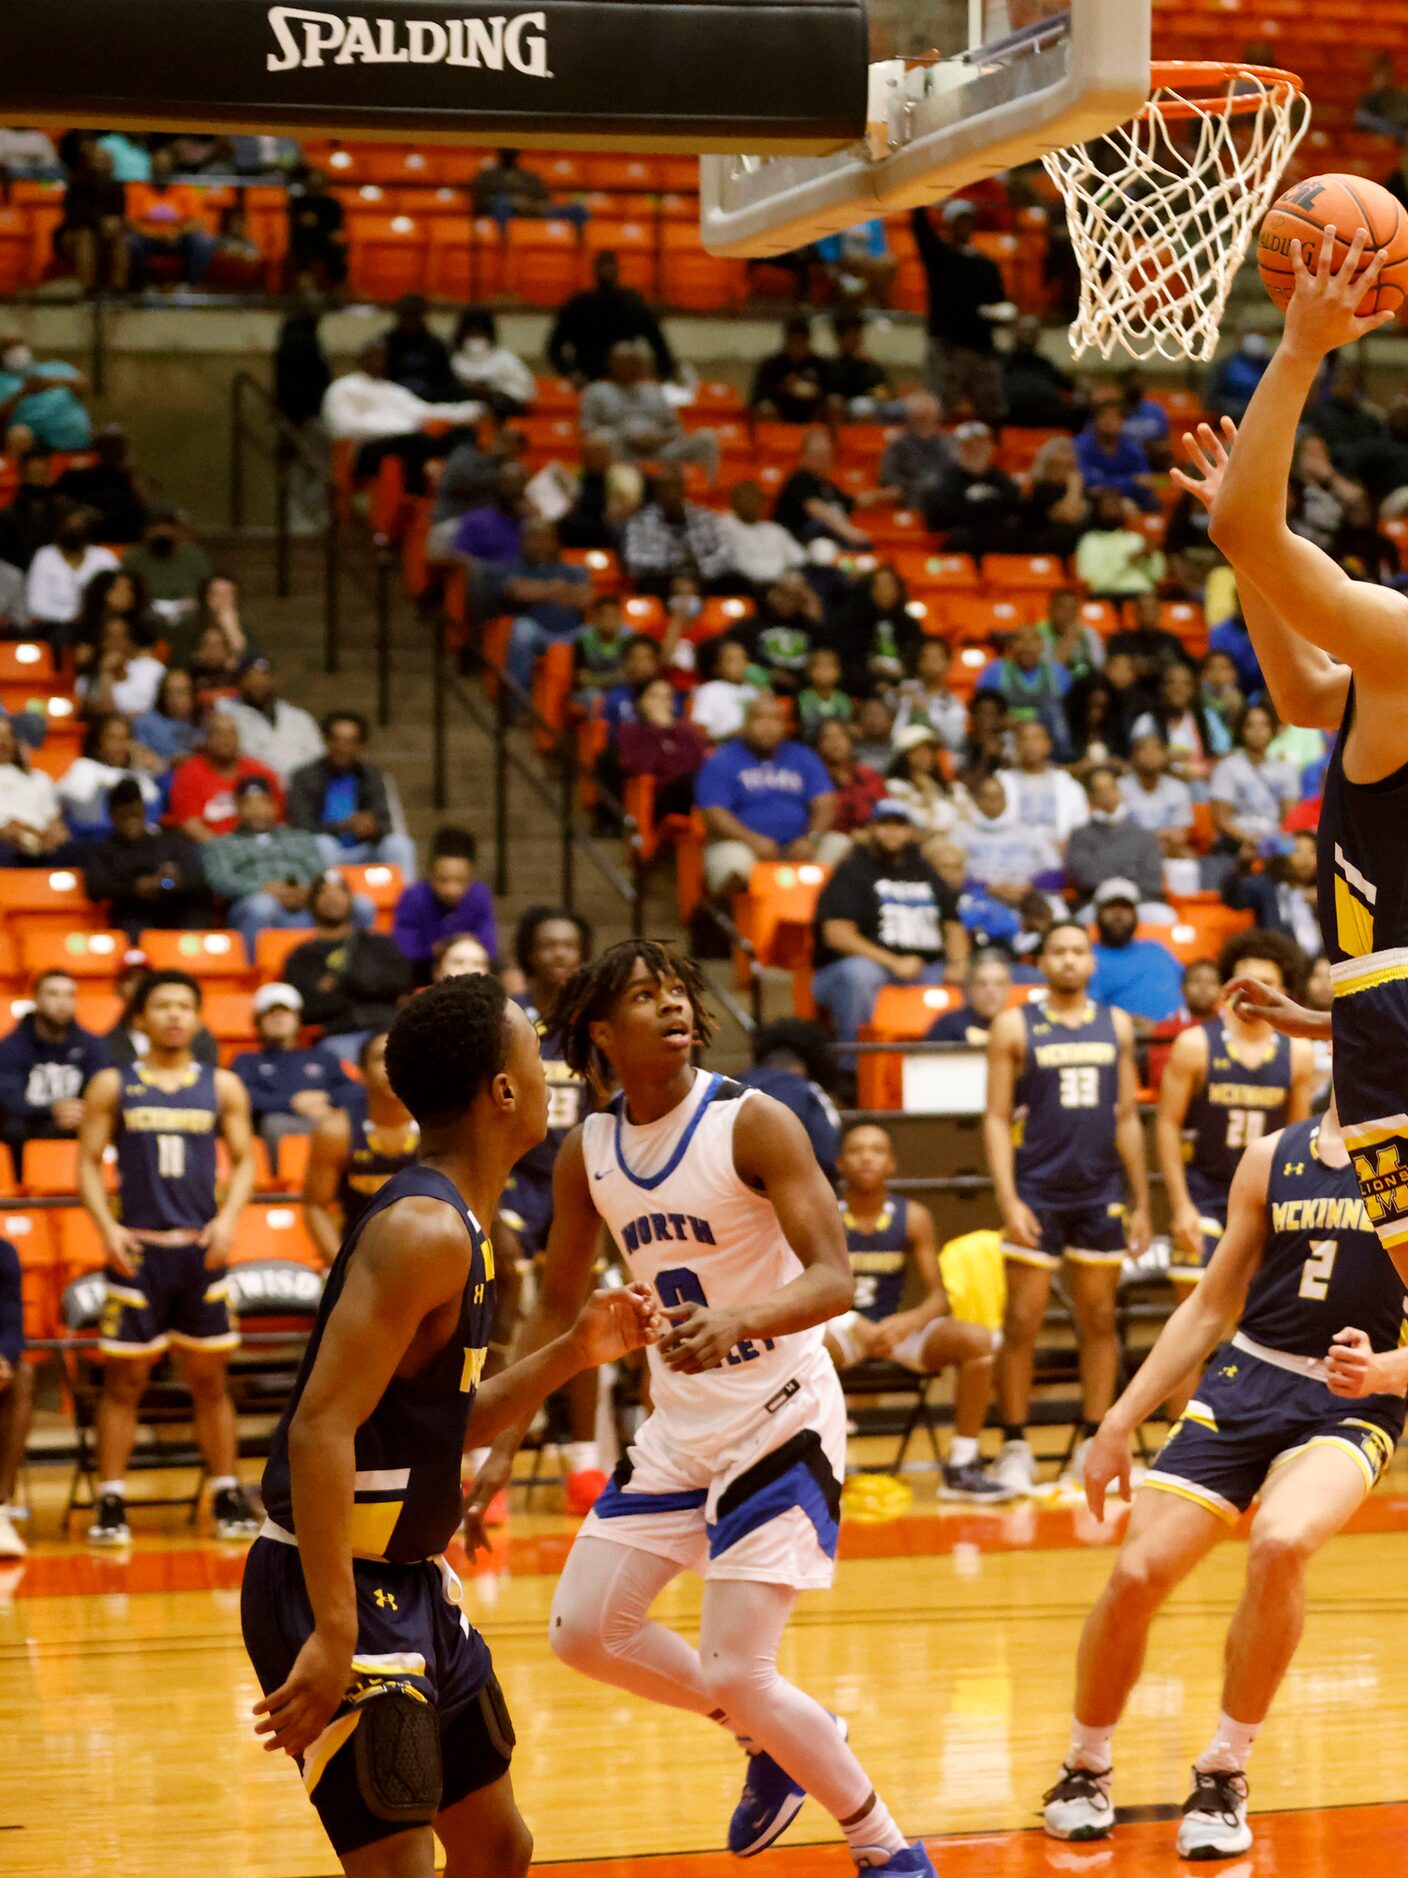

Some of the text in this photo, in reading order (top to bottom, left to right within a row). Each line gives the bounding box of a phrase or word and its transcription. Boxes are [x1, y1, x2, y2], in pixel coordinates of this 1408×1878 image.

[267, 6, 549, 78] SPALDING
[1058, 1066, 1100, 1108] 33
[157, 1134, 186, 1179] 11
[621, 1213, 717, 1256] NORTH
[1297, 1239, 1339, 1301] 2
